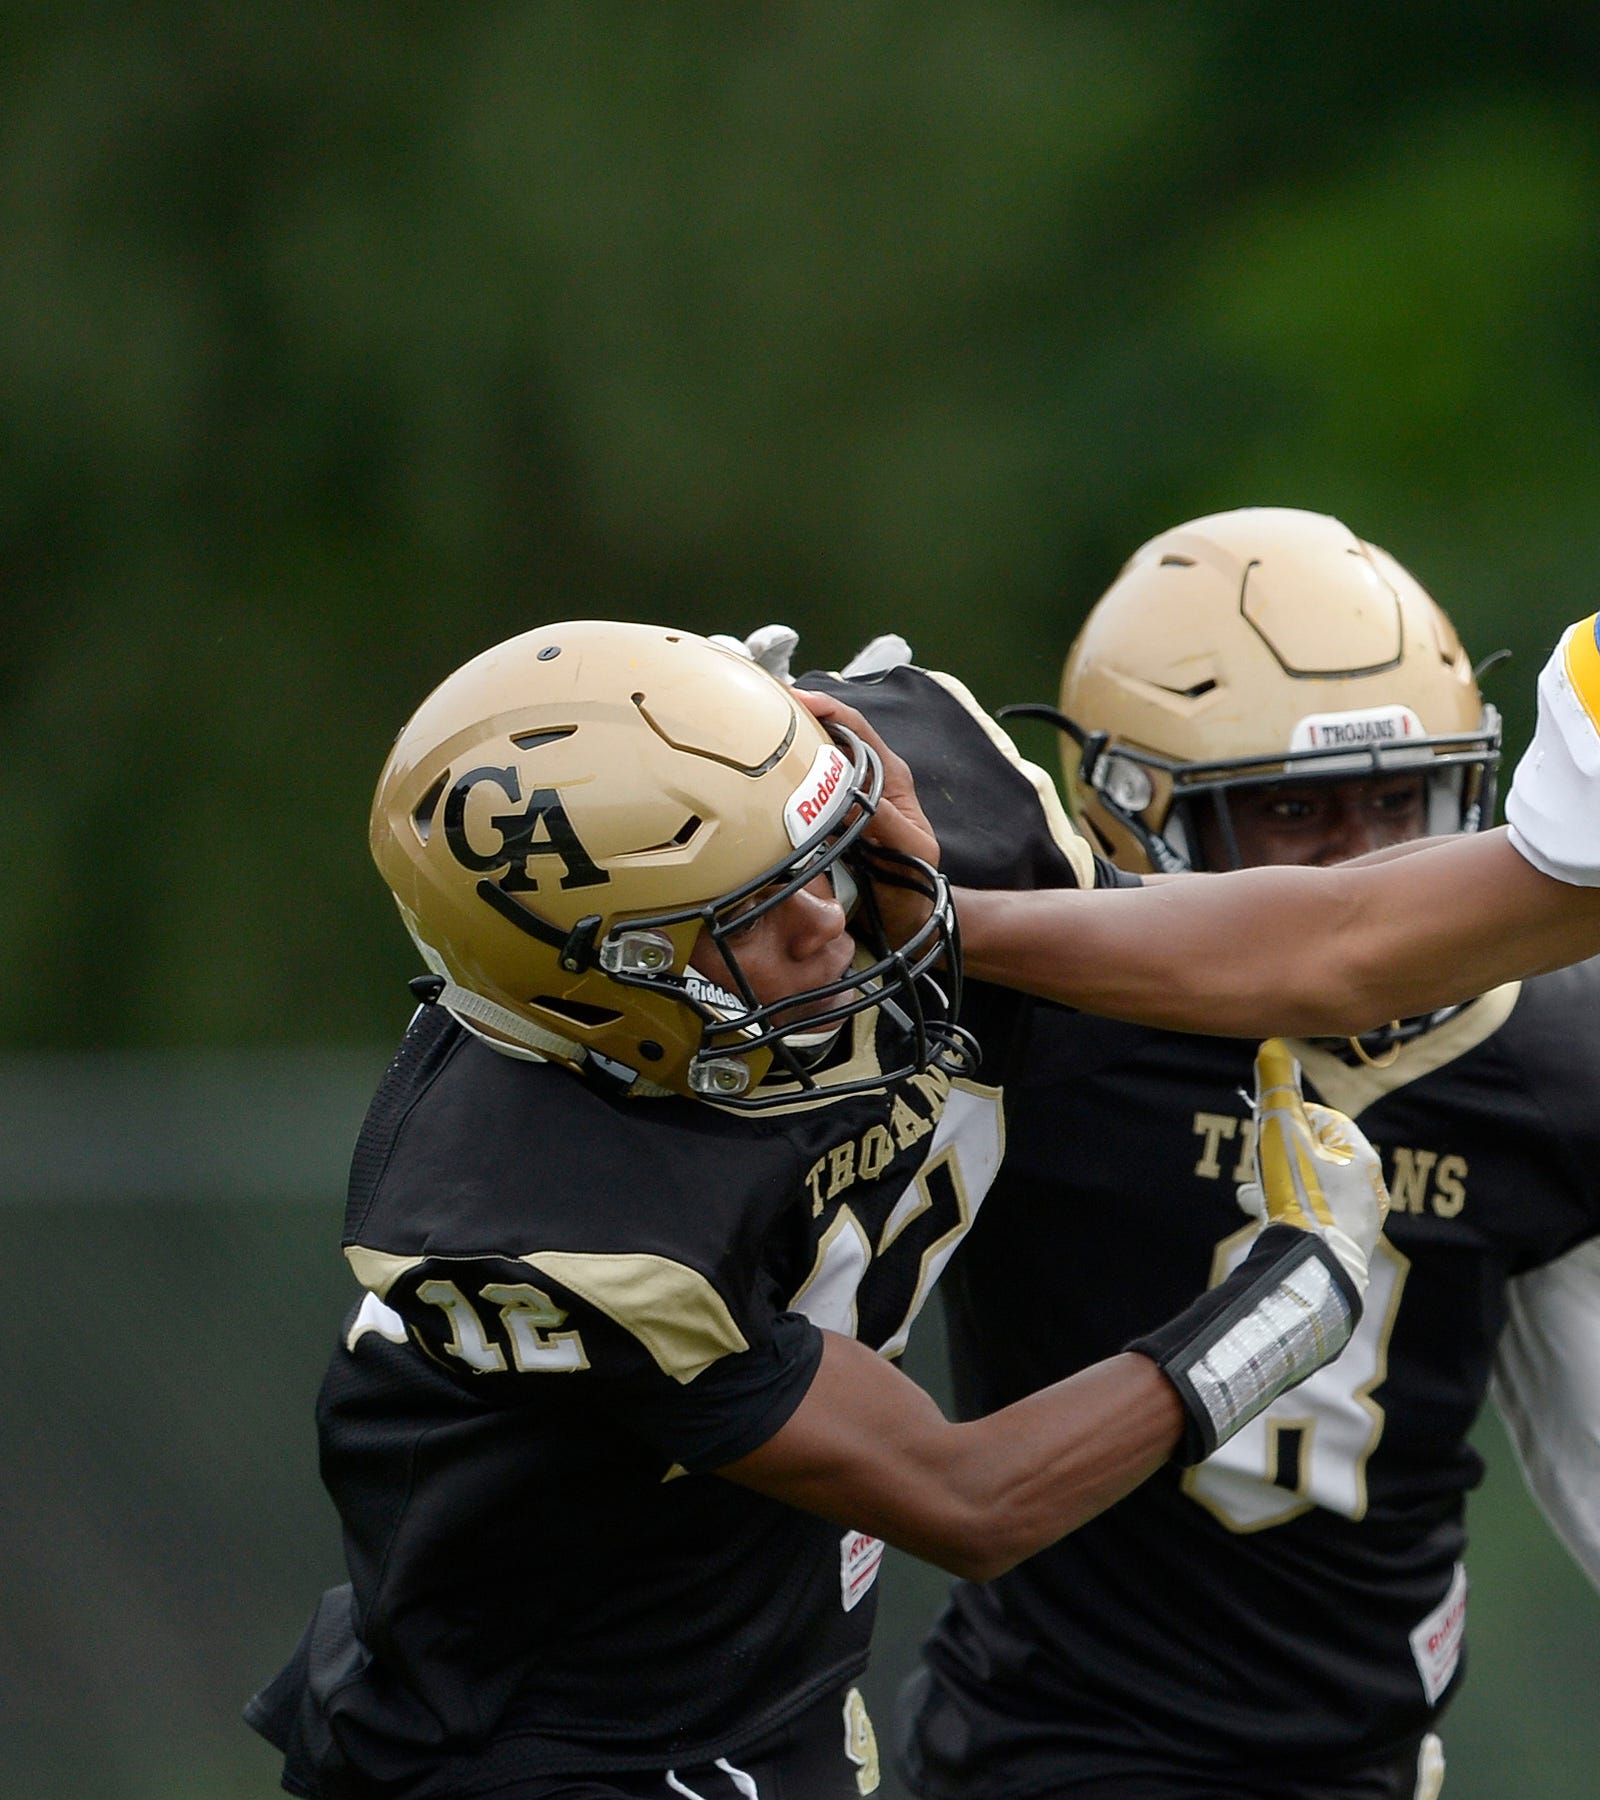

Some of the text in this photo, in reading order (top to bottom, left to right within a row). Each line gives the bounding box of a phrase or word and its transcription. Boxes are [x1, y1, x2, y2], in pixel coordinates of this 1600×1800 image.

[1322, 719, 1396, 744] TROJANS
[797, 751, 844, 825] Riddell
[415, 1279, 591, 1374] 12
